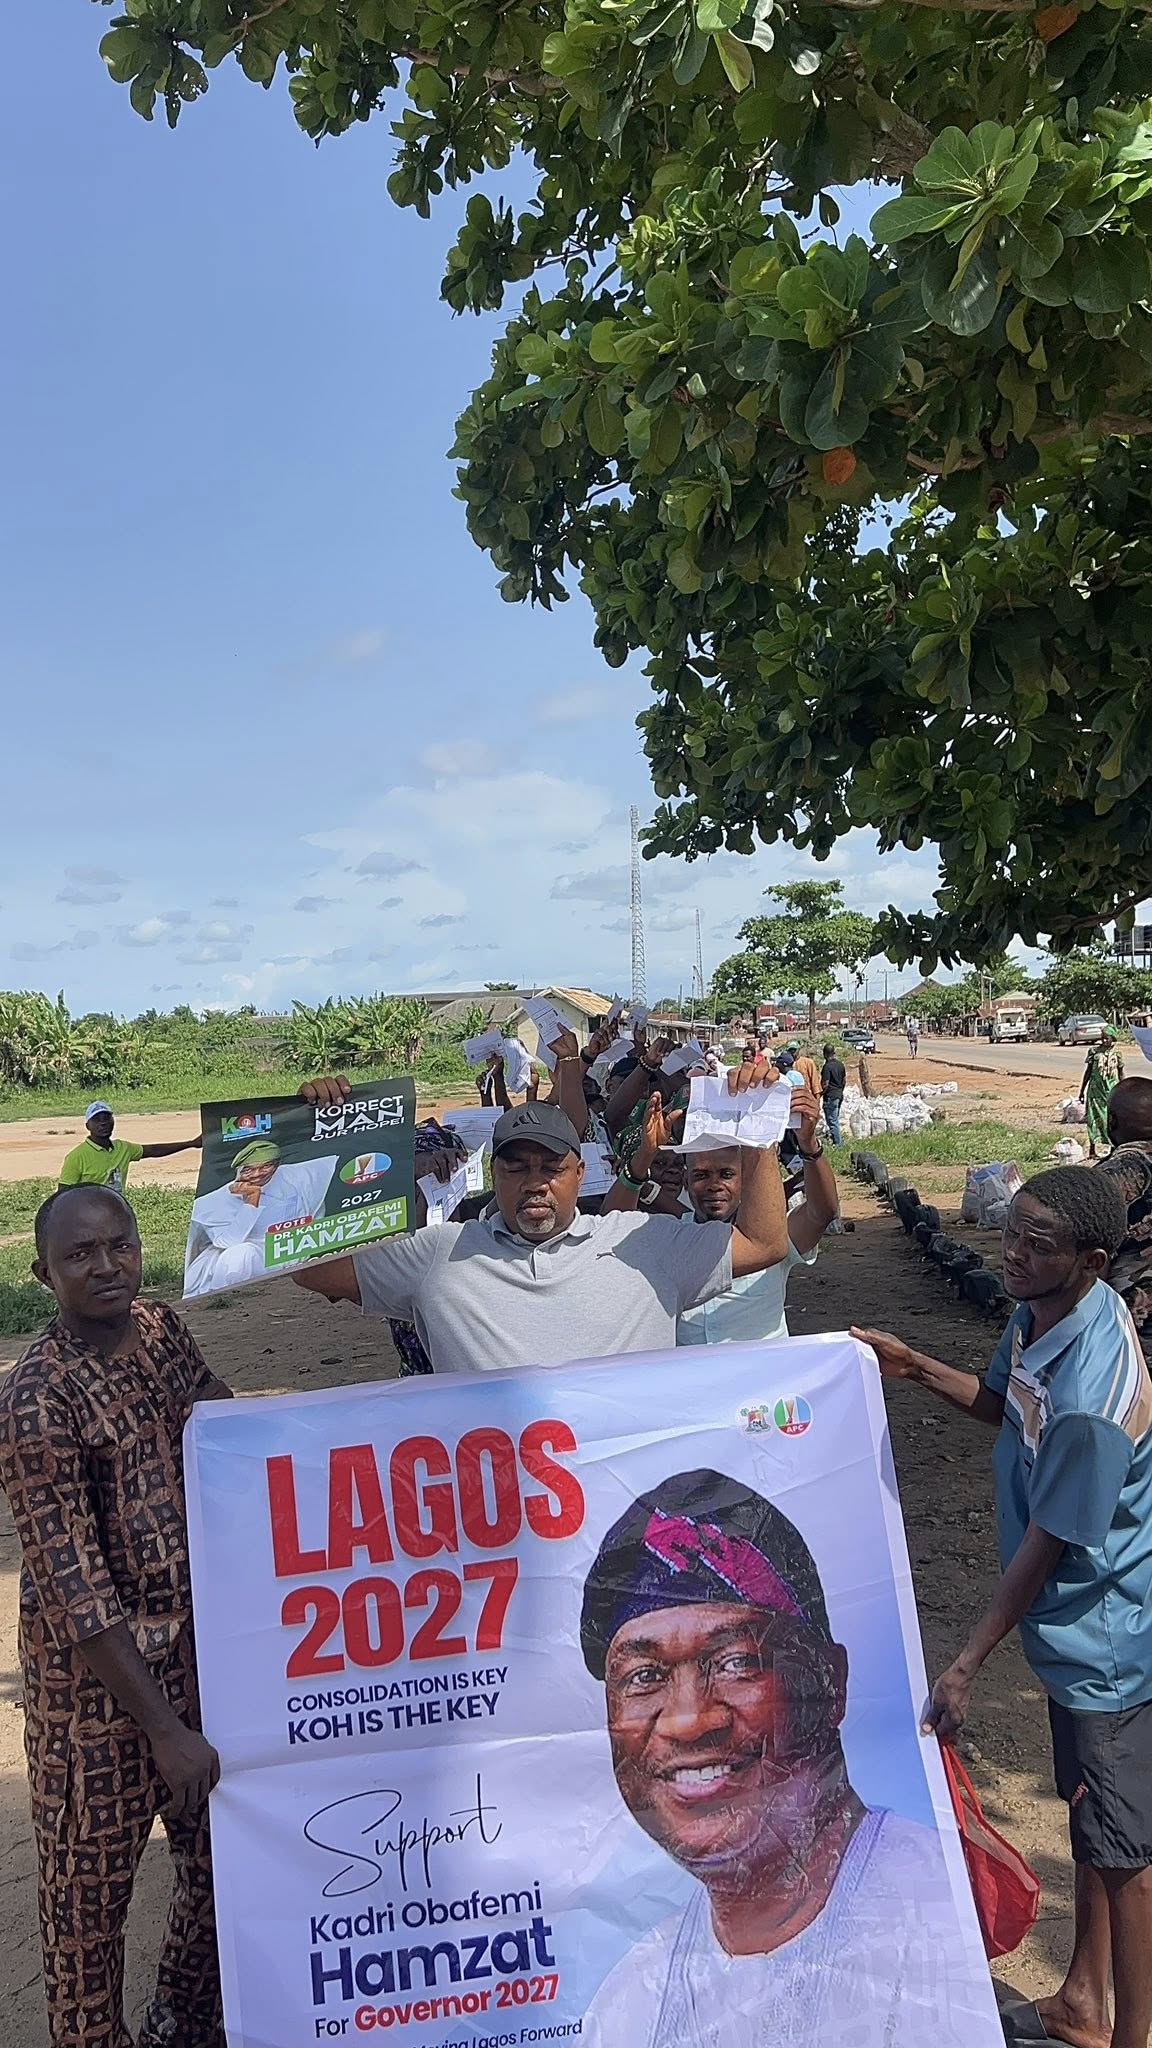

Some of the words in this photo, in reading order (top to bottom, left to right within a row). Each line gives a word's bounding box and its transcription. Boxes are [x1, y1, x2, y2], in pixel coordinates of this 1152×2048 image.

[315, 1095, 403, 1119] KORRECT
[315, 1105, 403, 1135] MAN
[311, 1129, 348, 1141] OUR
[341, 1189, 382, 1208] 2027
[352, 1172, 378, 1184] APC
[273, 1231, 294, 1242] DR.
[296, 1218, 335, 1236] KADRI
[336, 1201, 401, 1224] OBAFEMI
[273, 1210, 403, 1259] HAMZAT
[275, 1217, 306, 1231] VOTE
[786, 1424, 804, 1433] APC
[266, 1418, 586, 1578] LAGOS
[281, 1556, 520, 1679] 2027
[287, 1674, 449, 1714] CONSOLIDATION
[452, 1672, 469, 1690] IS
[472, 1666, 509, 1687] KEY
[288, 1713, 353, 1746] KOH
[358, 1709, 384, 1735] IS
[387, 1700, 442, 1730] THE
[446, 1691, 500, 1722] KEY
[303, 1773, 503, 1897] Support
[310, 1902, 395, 1944] Kadri
[401, 1880, 542, 1928] Obafemi
[309, 1916, 556, 2006] Hamzat
[315, 2016, 350, 2038] For
[354, 1989, 492, 2031] Governor
[494, 1973, 560, 2009] 2027
[520, 2018, 583, 2043] Forward
